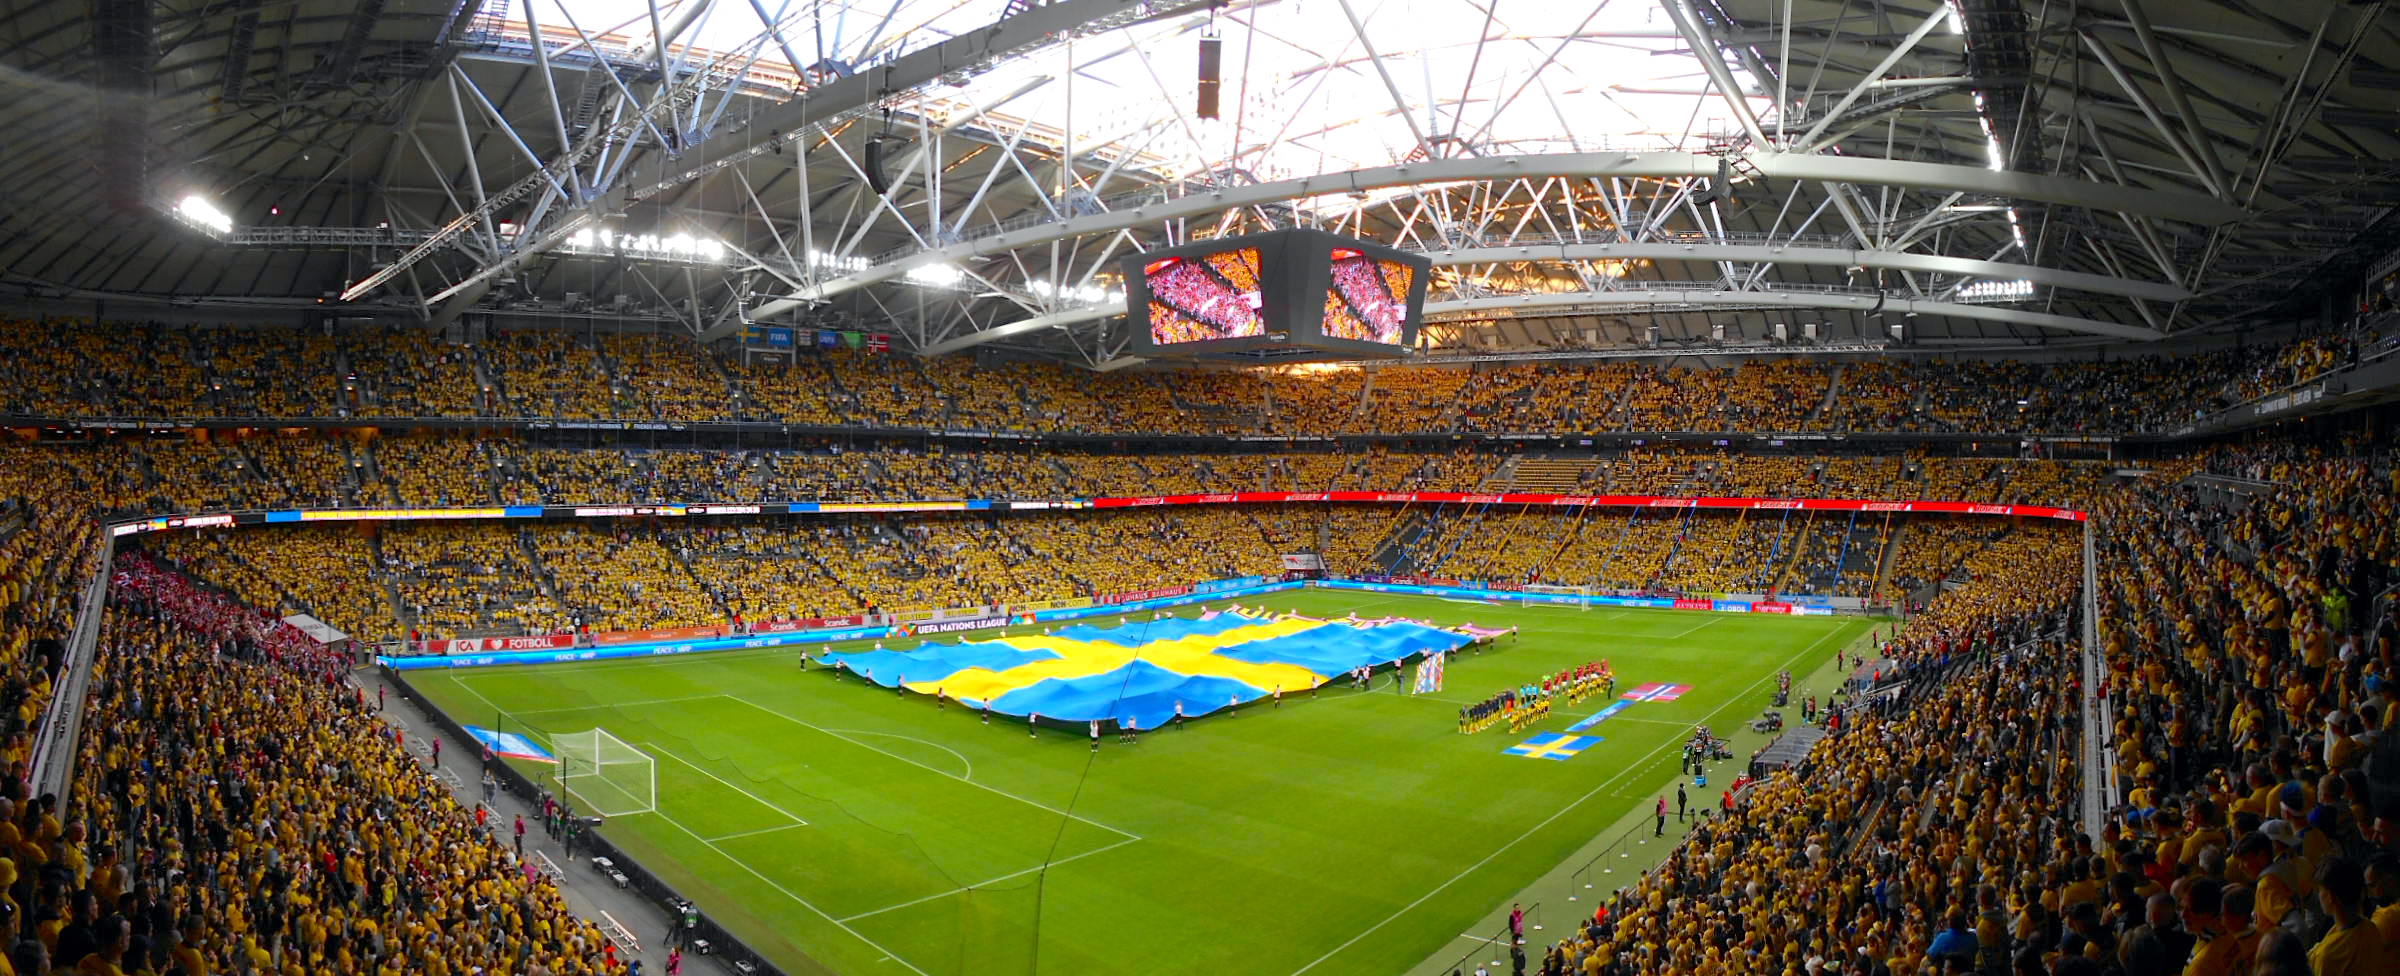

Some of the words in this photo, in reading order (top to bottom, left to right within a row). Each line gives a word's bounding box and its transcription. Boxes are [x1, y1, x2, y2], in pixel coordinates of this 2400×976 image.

[770, 333, 787, 341] FIFA
[1391, 576, 1415, 585] Scandic
[770, 622, 797, 632] Scandic
[824, 619, 850, 628] Scandic
[918, 624, 938, 634] UEFA
[940, 621, 975, 632] NATIONS
[977, 618, 1007, 628] LEAGUE
[456, 641, 473, 652] ICA
[509, 637, 553, 649] FOTBOLL
